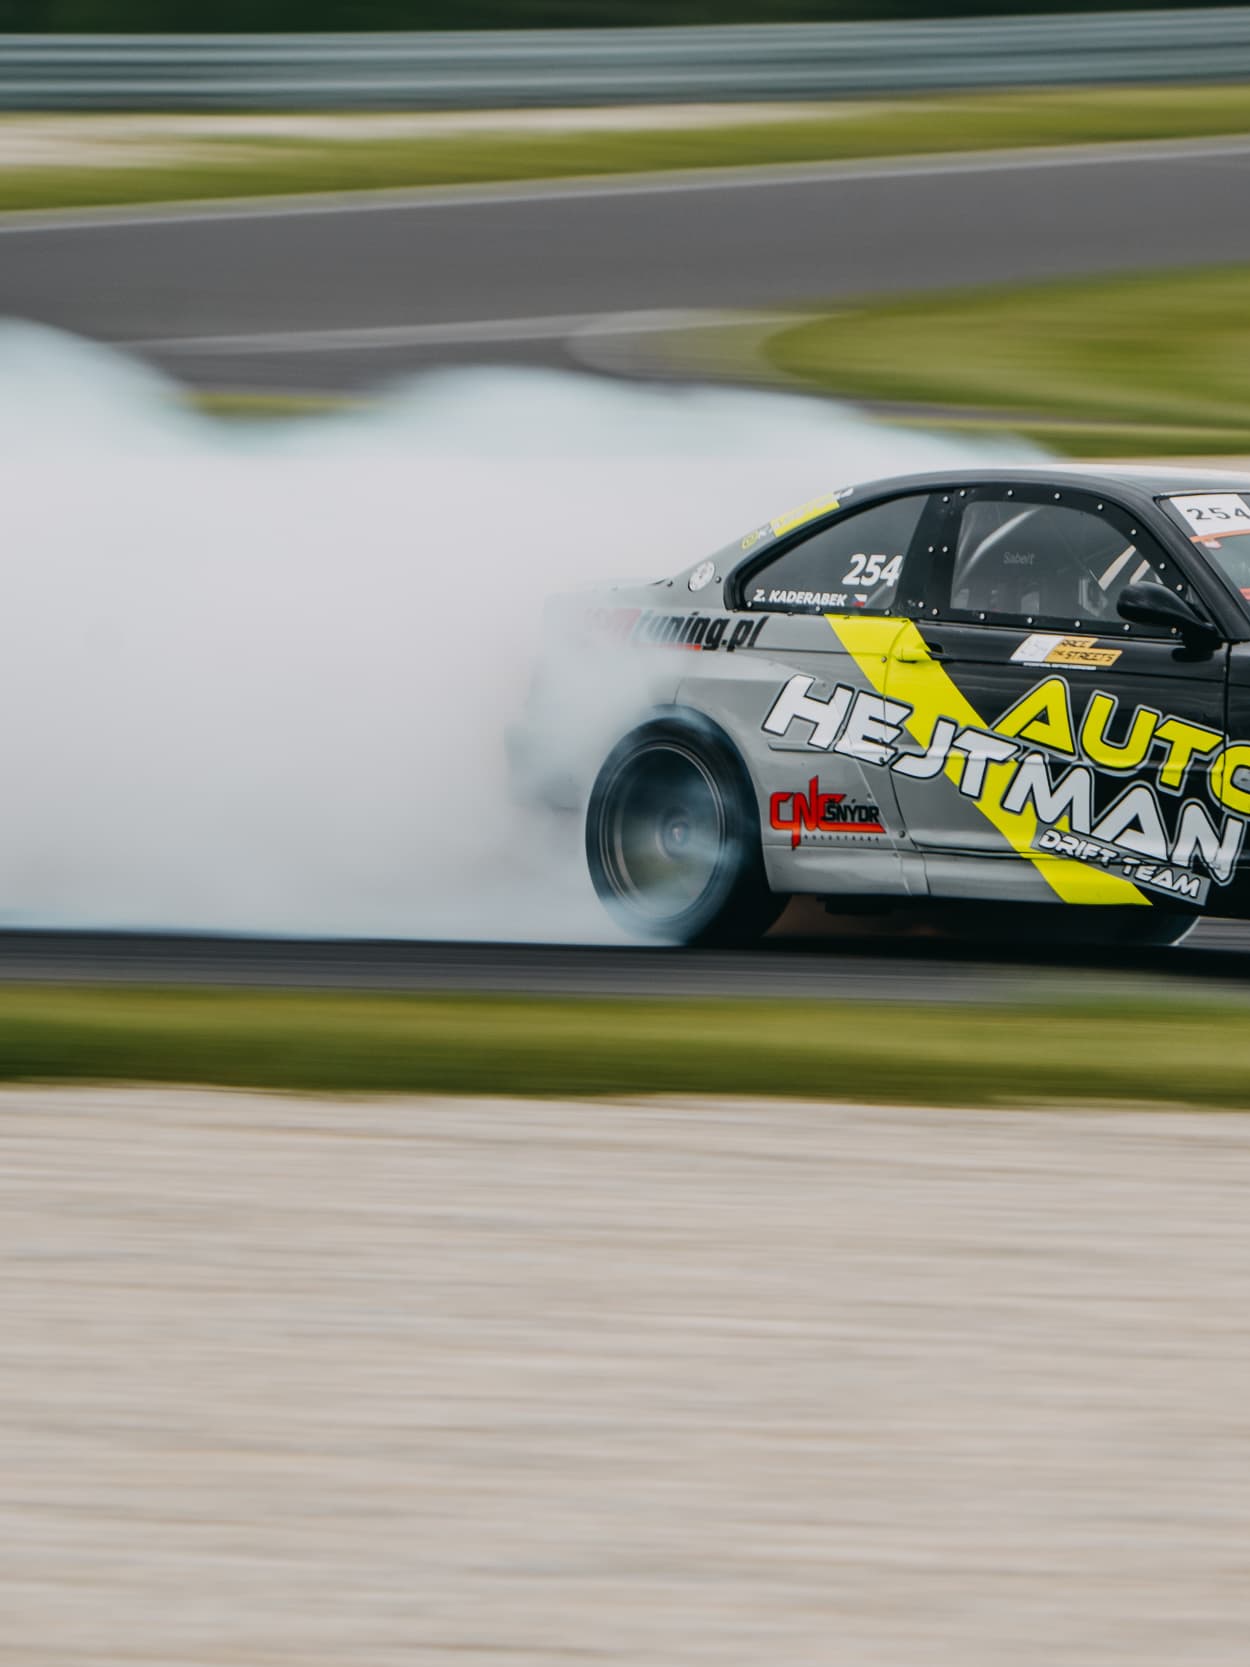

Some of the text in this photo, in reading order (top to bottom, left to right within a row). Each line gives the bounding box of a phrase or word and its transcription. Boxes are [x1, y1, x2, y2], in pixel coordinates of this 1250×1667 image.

[842, 553, 903, 587] 254
[753, 589, 848, 607] Z. KADERABEK
[760, 673, 1246, 887] HEJTMAN
[1037, 828, 1202, 899] DRIFT TEAM
